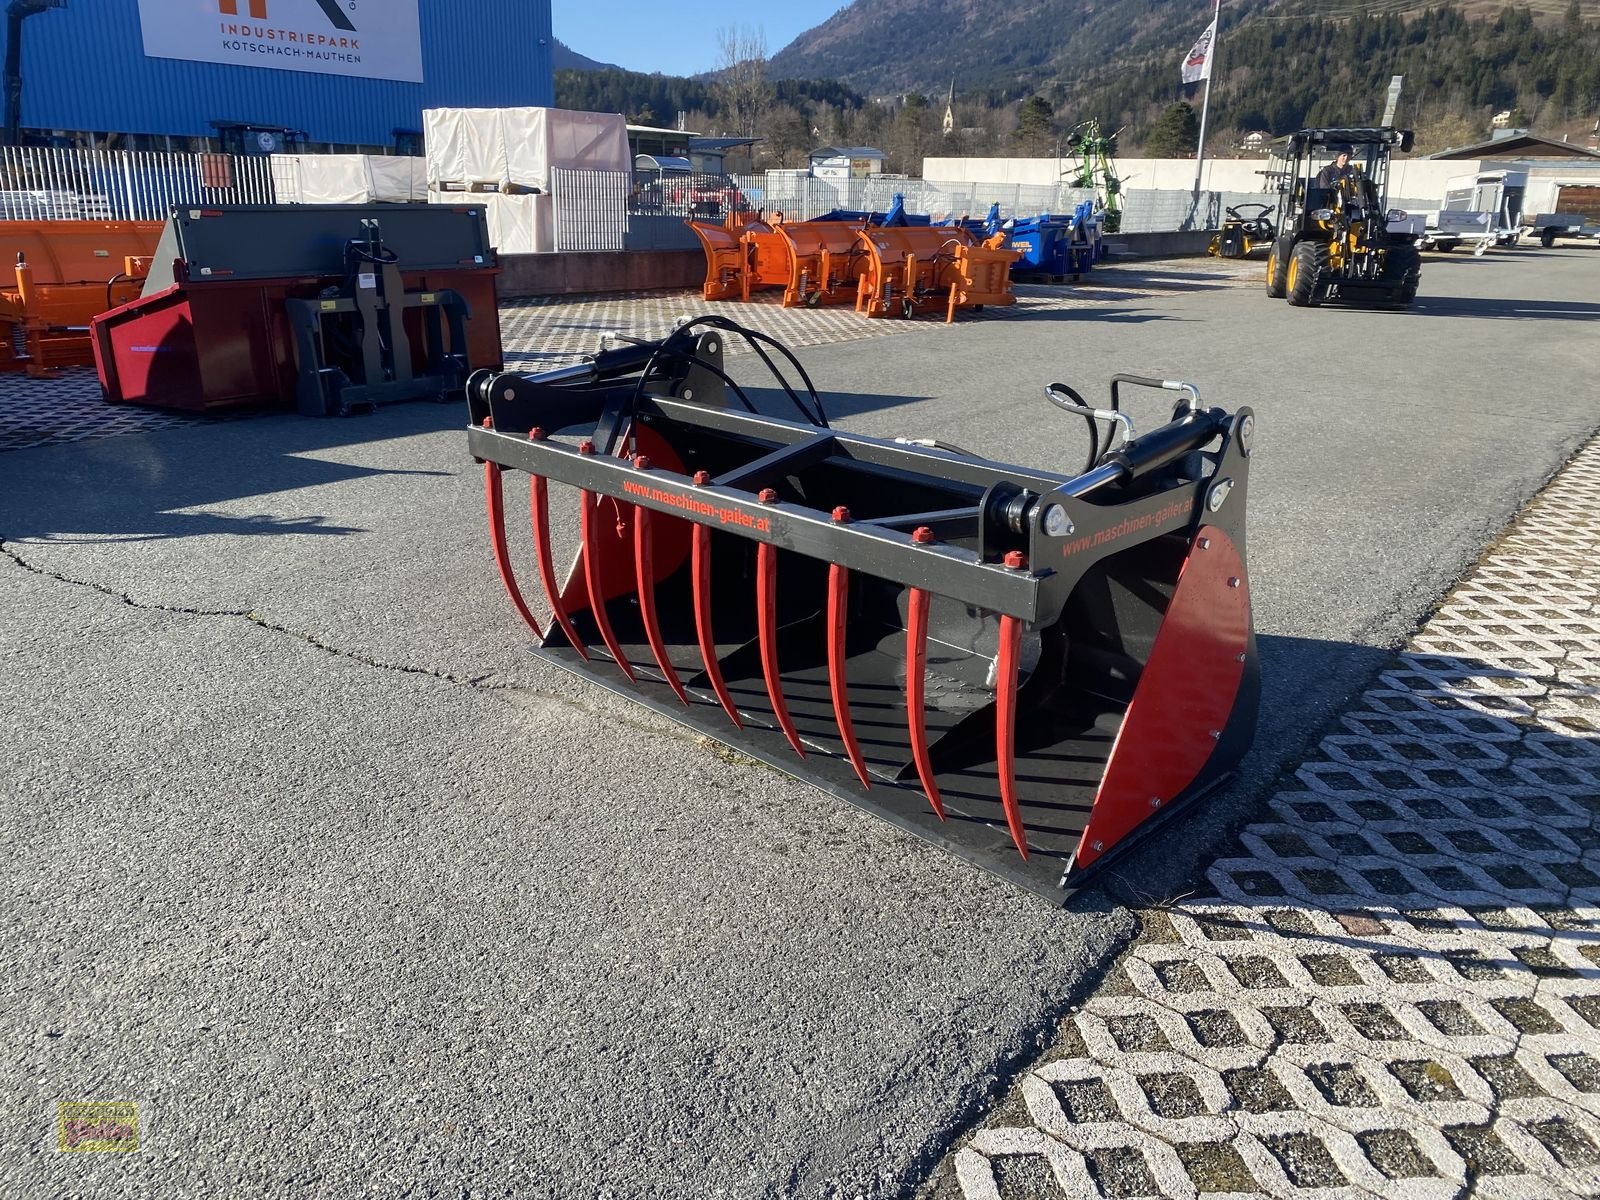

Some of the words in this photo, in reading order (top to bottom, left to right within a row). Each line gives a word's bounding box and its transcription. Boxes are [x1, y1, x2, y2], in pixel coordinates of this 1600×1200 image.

[220, 23, 360, 49] INDUSTRIEPARK
[223, 40, 361, 63] KÖTSCHACH-MAUTHEN
[623, 480, 770, 532] www.maschinen-gailer.at
[1062, 497, 1193, 557] www.maschinen-gailer.at
